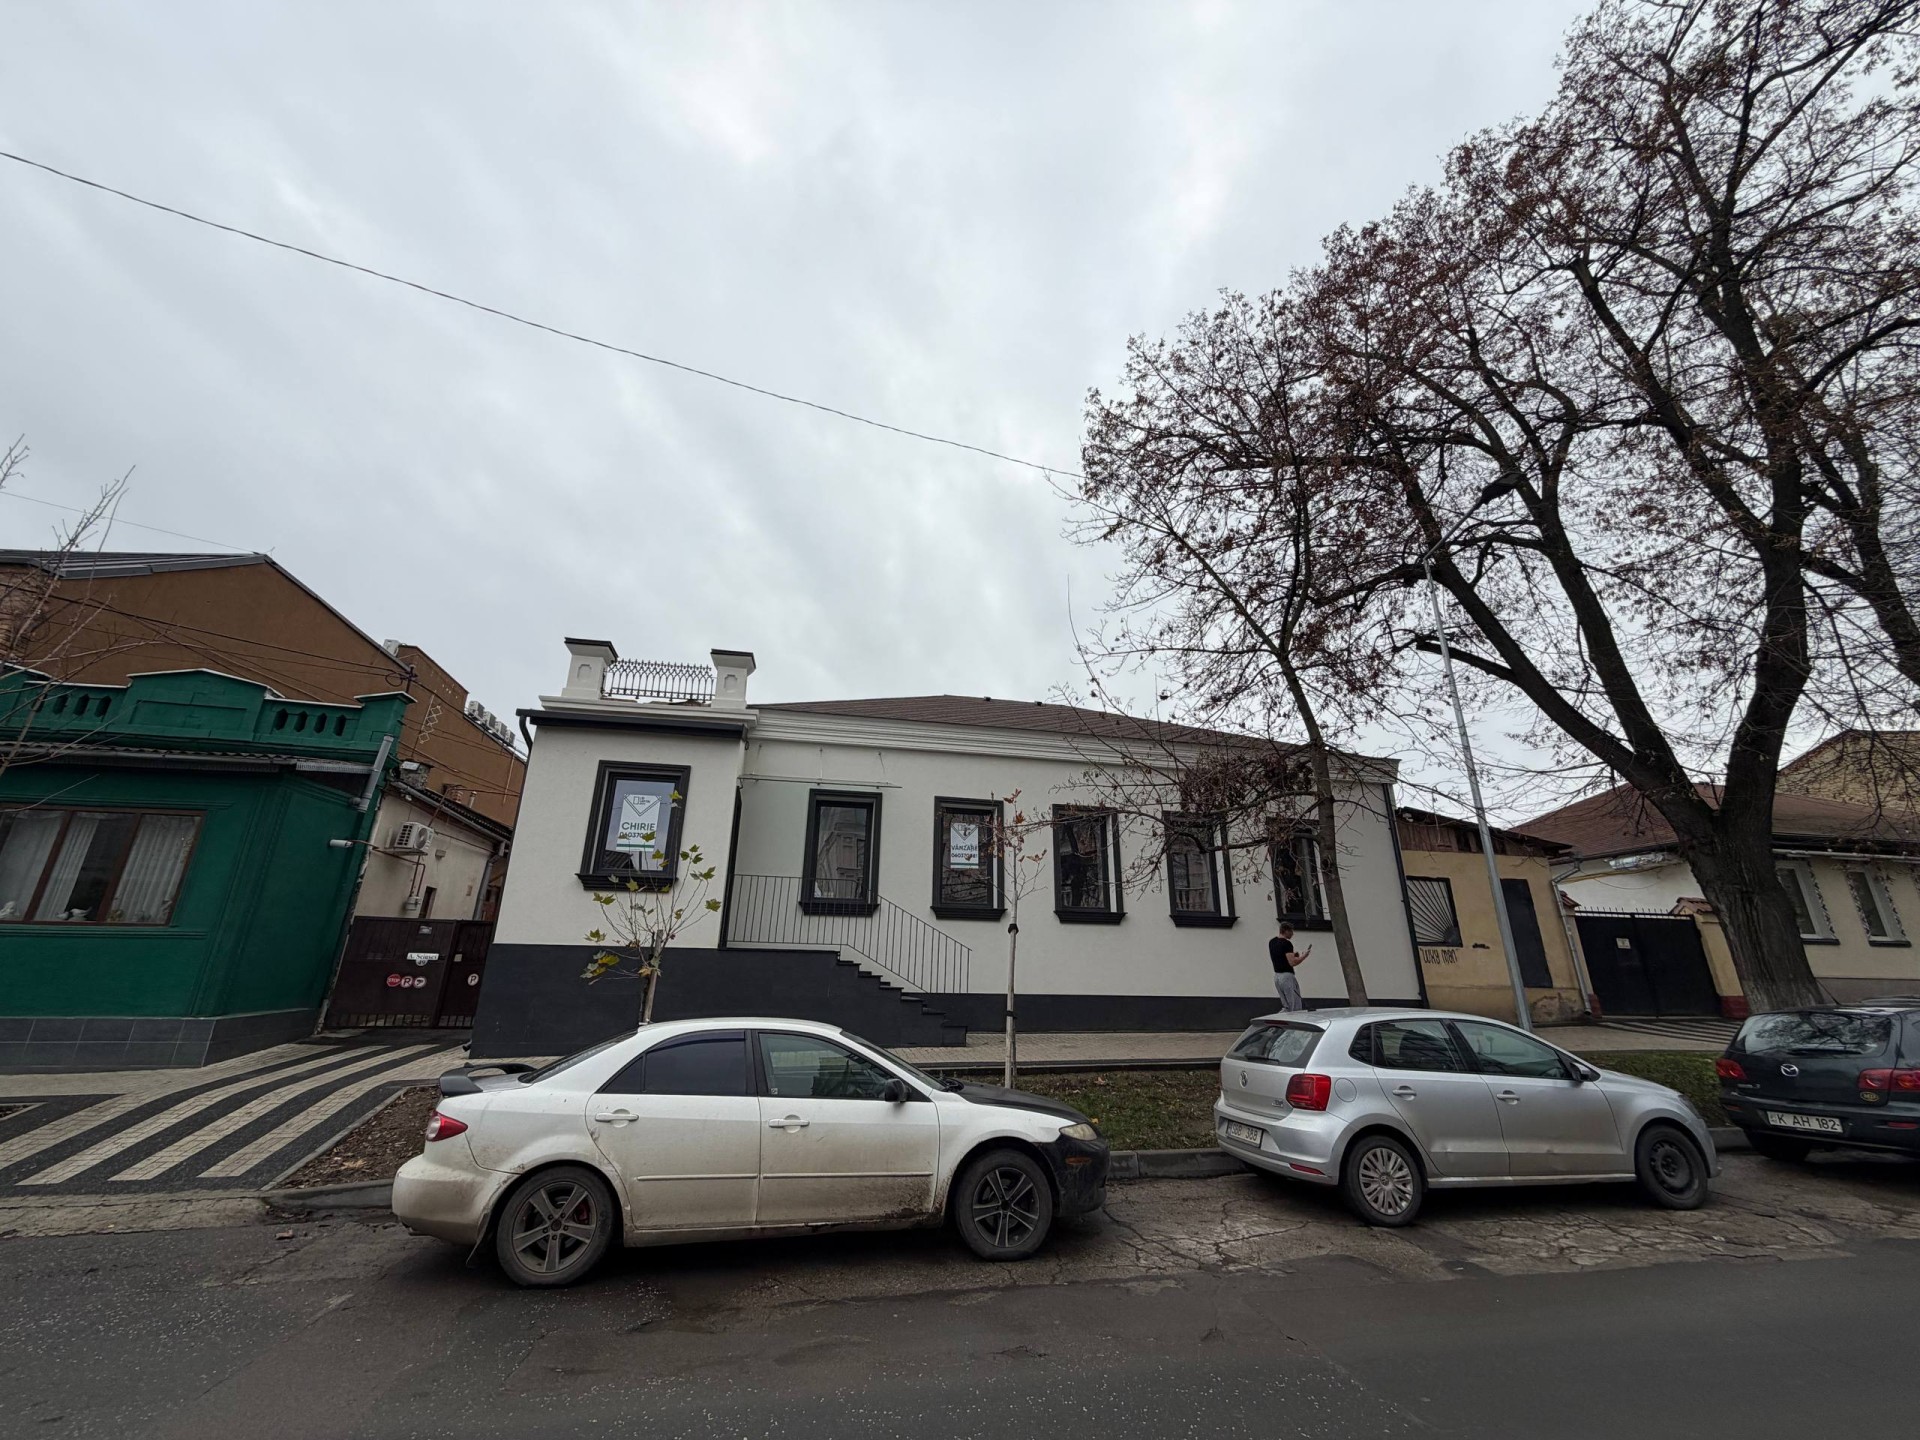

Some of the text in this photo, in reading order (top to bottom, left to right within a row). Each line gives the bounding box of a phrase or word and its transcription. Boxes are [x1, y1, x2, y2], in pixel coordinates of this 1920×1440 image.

[622, 822, 655, 831] CHIRIE
[1777, 1113, 1838, 1131] K AH 182
